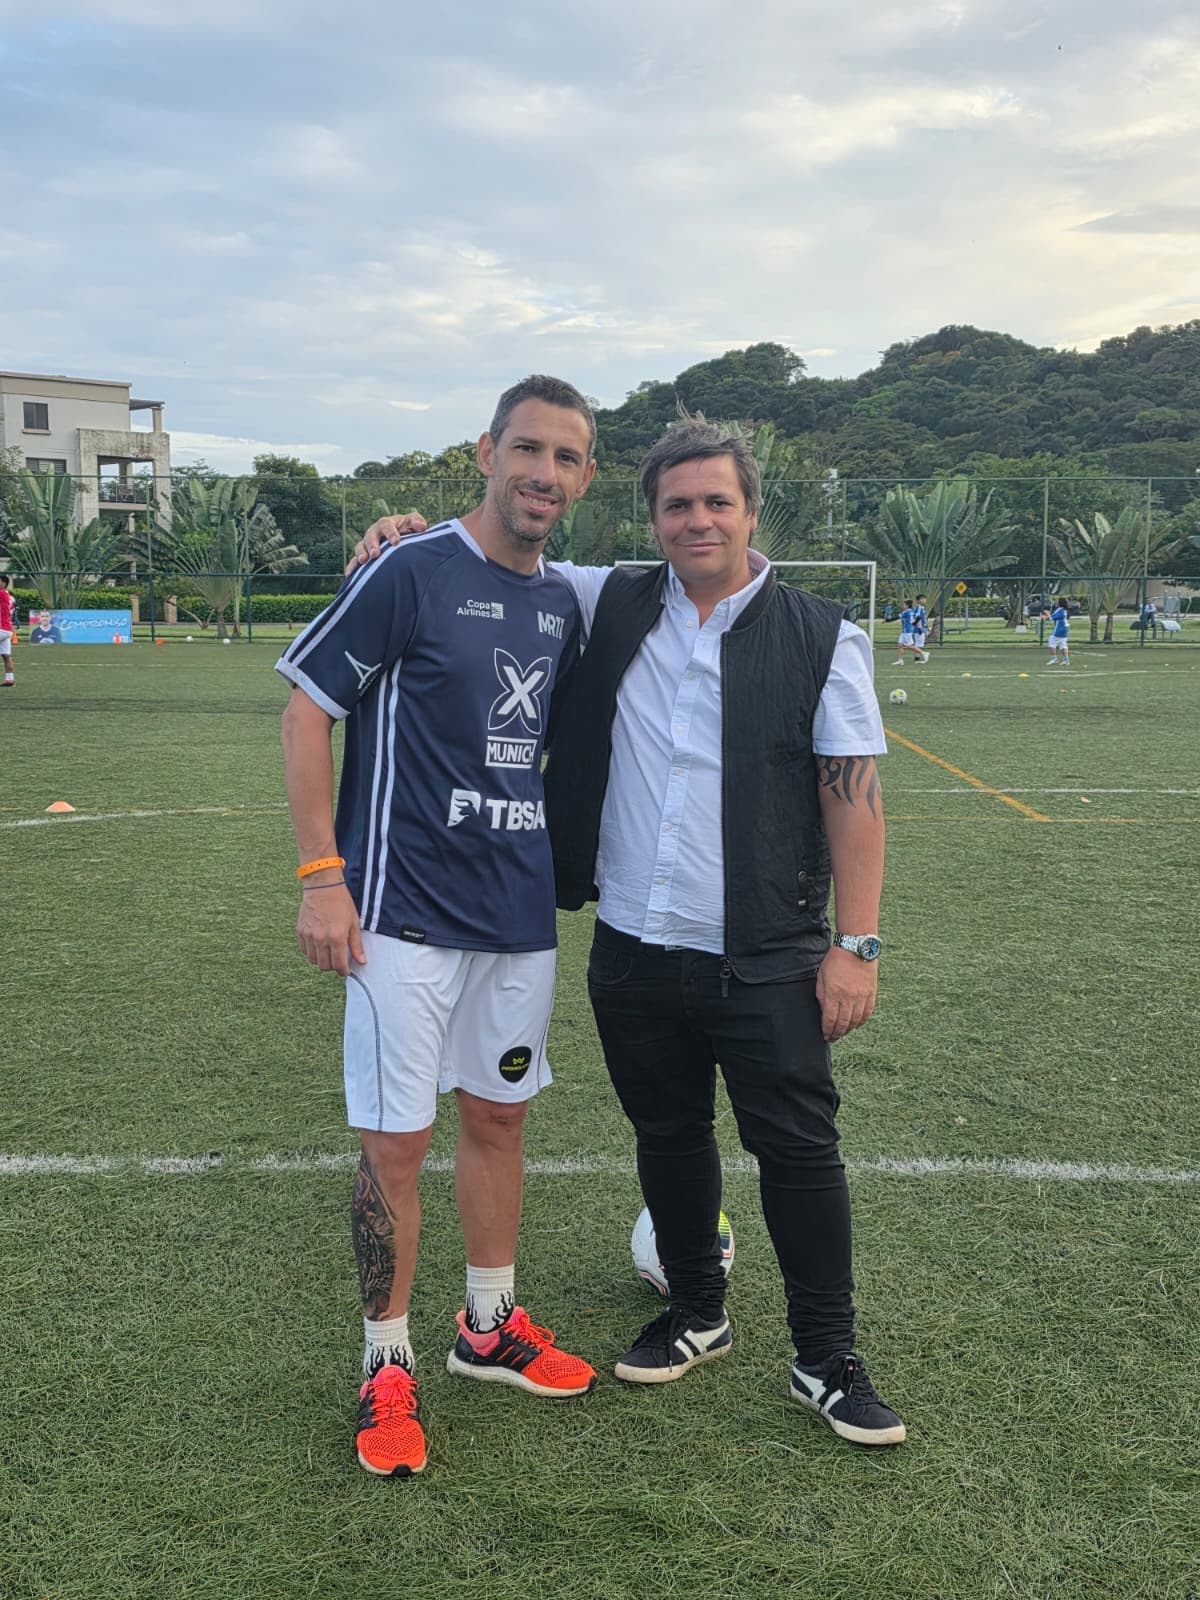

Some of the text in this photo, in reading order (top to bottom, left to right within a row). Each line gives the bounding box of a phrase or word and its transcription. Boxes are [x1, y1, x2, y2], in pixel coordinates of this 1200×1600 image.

[456, 607, 491, 618] Airlines
[466, 599, 491, 610] Copa
[487, 741, 534, 763] MUNICH
[485, 798, 546, 831] TBSA
